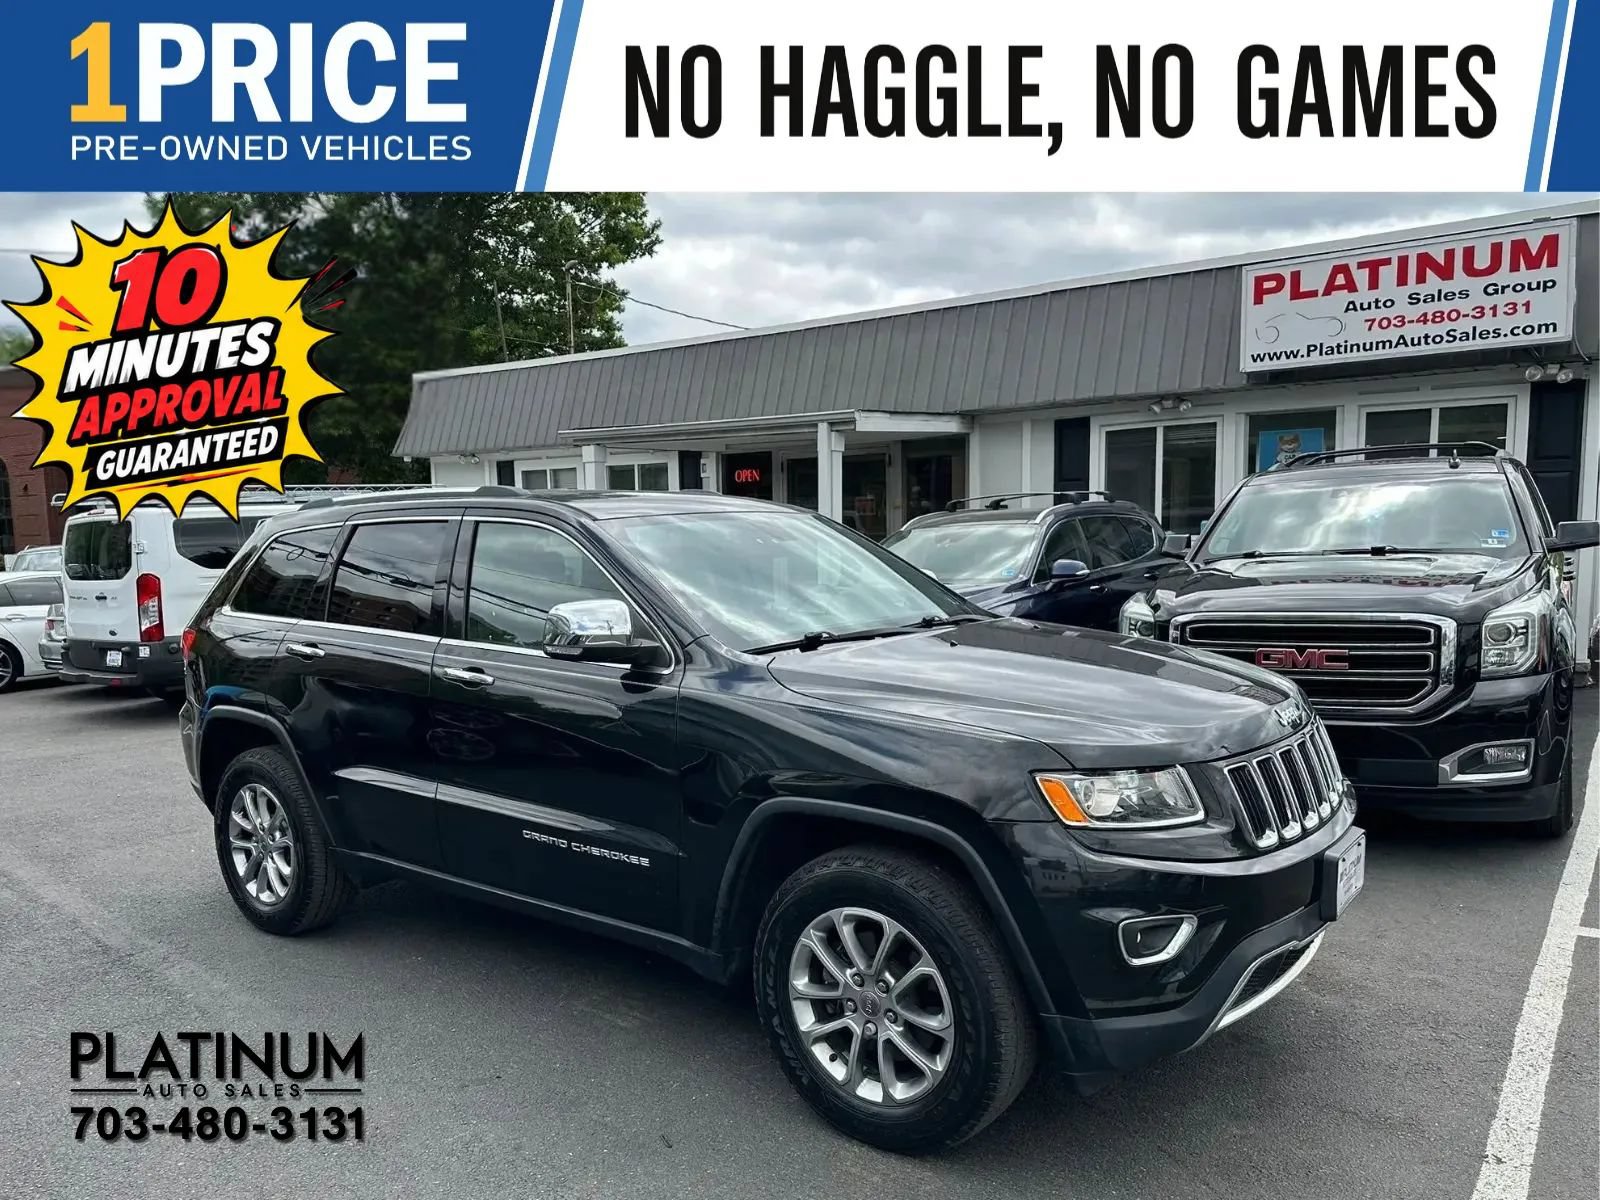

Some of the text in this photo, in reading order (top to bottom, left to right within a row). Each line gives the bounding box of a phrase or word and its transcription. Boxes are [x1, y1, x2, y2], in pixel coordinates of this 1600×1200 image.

[1253, 233, 1559, 306] PLATINUM
[1344, 278, 1557, 313] Auto Sales Group
[1364, 300, 1532, 332] 703-480-3131
[1250, 320, 1558, 364] www.PlatinumAutoSales.com
[735, 469, 760, 482] OPEN
[1256, 648, 1349, 669] GMC
[522, 829, 650, 867] GRAND CHEROKEE
